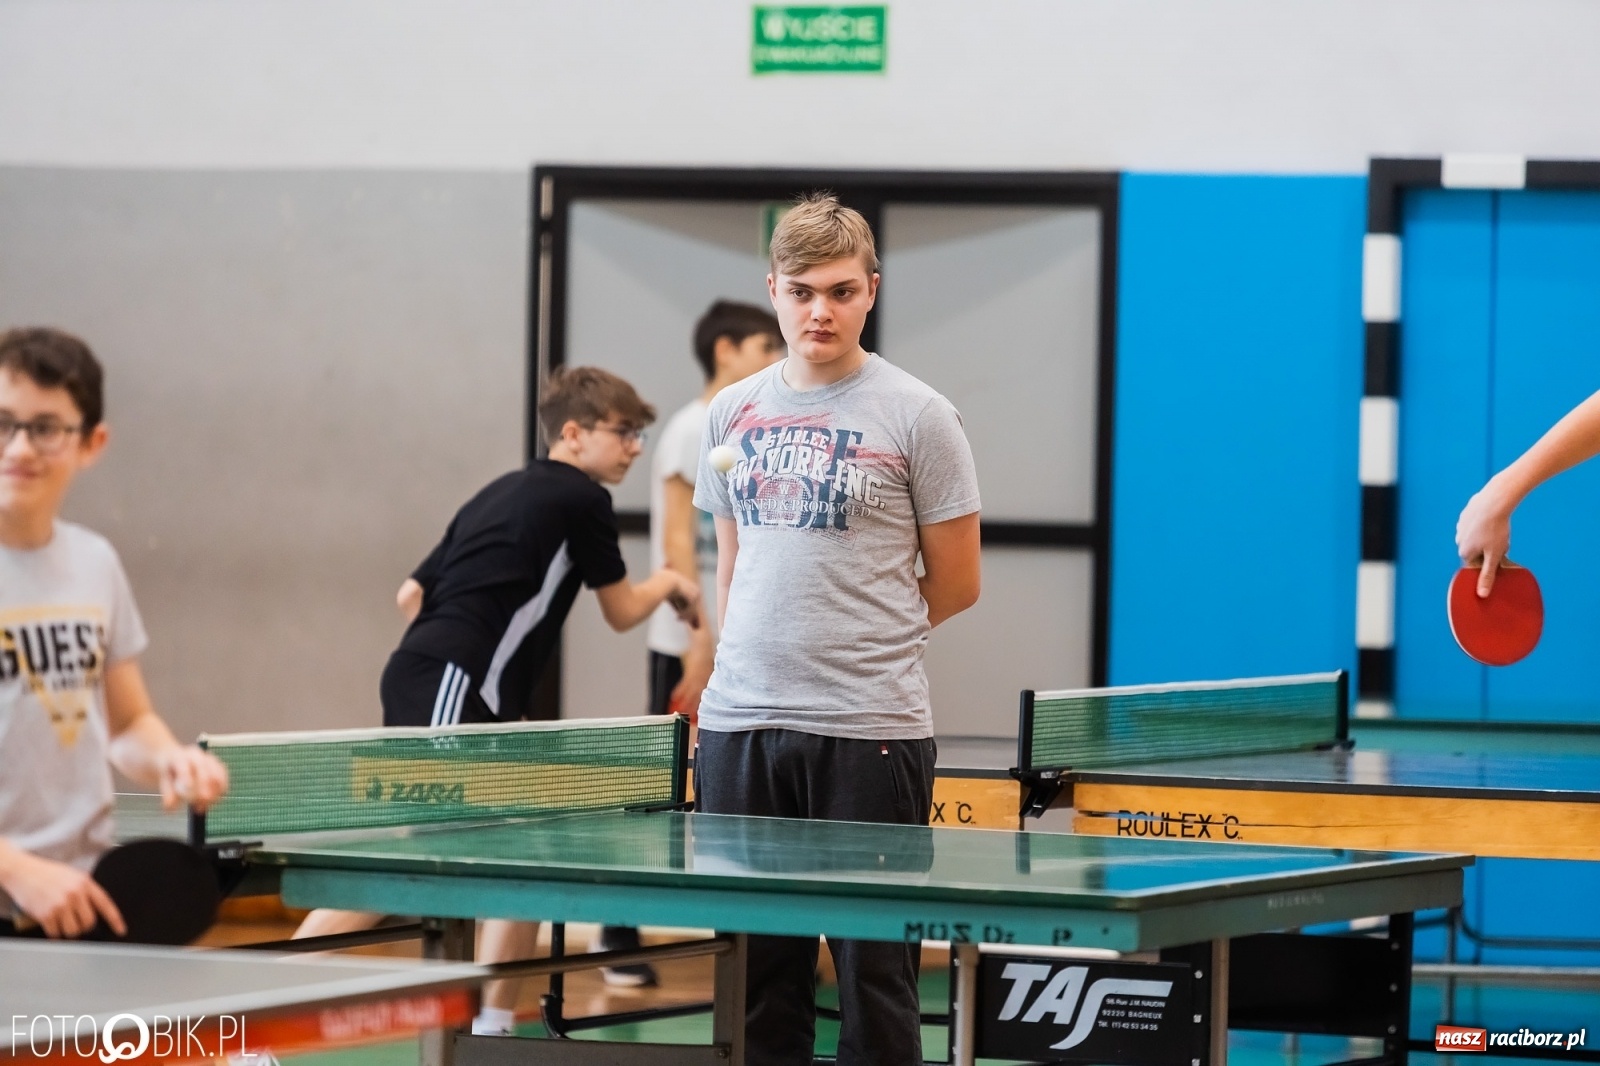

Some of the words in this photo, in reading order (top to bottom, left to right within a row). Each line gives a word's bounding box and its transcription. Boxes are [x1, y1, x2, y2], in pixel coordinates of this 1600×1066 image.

[763, 445, 831, 484] YORK
[832, 458, 886, 511] INC.
[791, 499, 871, 517] PRODUCED
[0, 622, 104, 679] GUES
[997, 962, 1174, 1050] TAS
[1102, 1009, 1126, 1017] 92220
[1127, 1011, 1162, 1019] BAGNEUX
